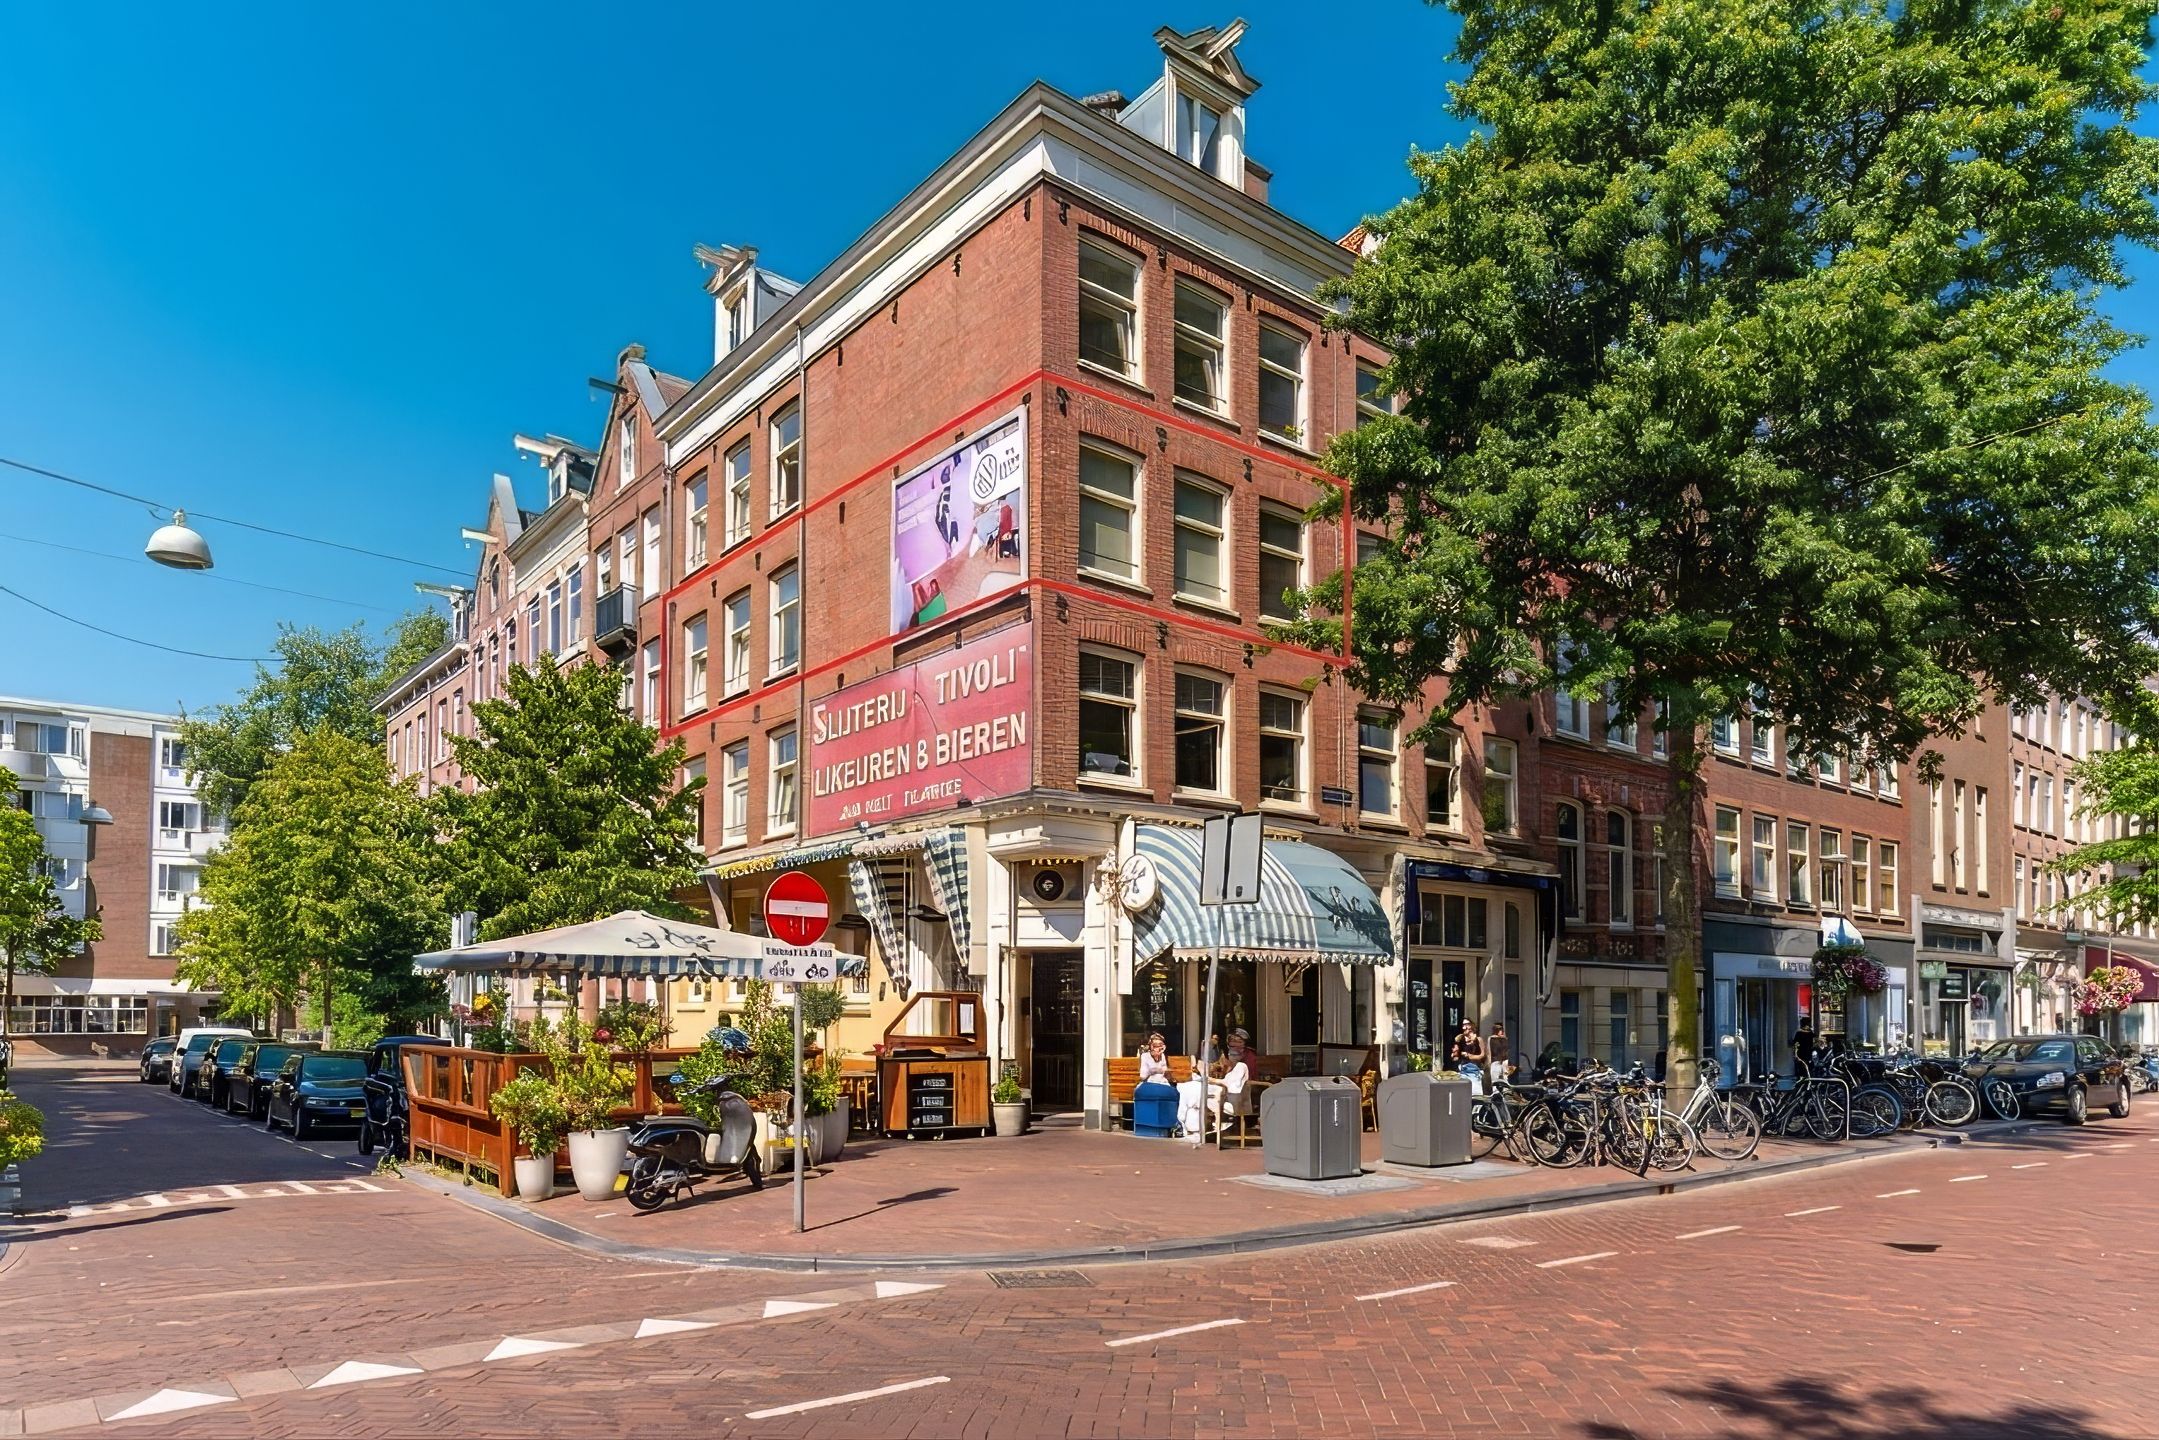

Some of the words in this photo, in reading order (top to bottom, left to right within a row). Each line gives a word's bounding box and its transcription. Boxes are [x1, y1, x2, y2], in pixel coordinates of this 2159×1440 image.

[812, 689, 906, 745] SLIJTERIJ
[934, 648, 1016, 705] TIVOLI
[814, 743, 911, 797] LIKEUREN
[935, 711, 1026, 767] BIEREN
